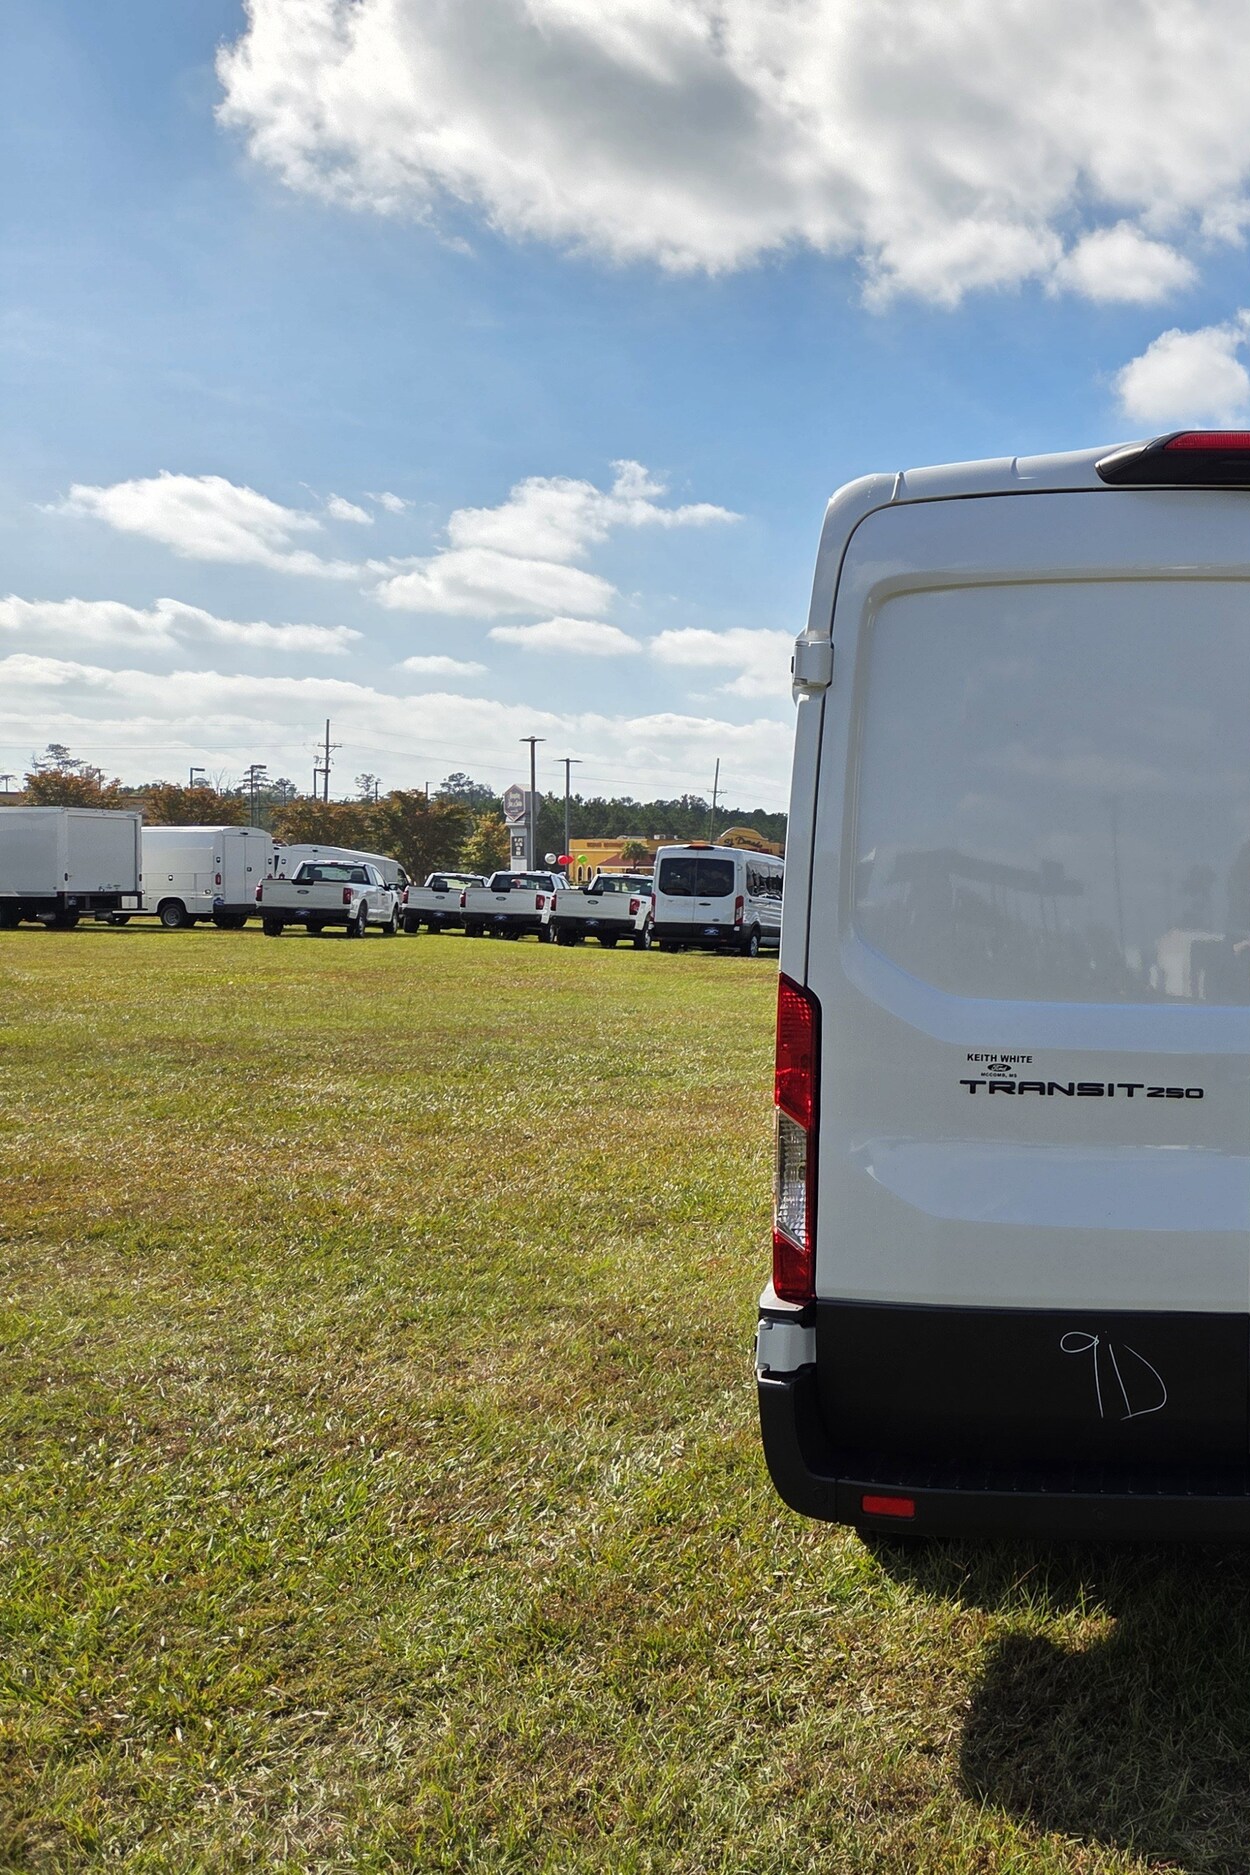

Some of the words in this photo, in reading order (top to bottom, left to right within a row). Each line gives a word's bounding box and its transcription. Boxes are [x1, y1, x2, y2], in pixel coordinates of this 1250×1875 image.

[967, 1053, 997, 1062] KEITH
[1000, 1054, 1033, 1063] WHITE
[959, 1079, 1145, 1098] TRANSIT
[1146, 1087, 1204, 1099] 250
